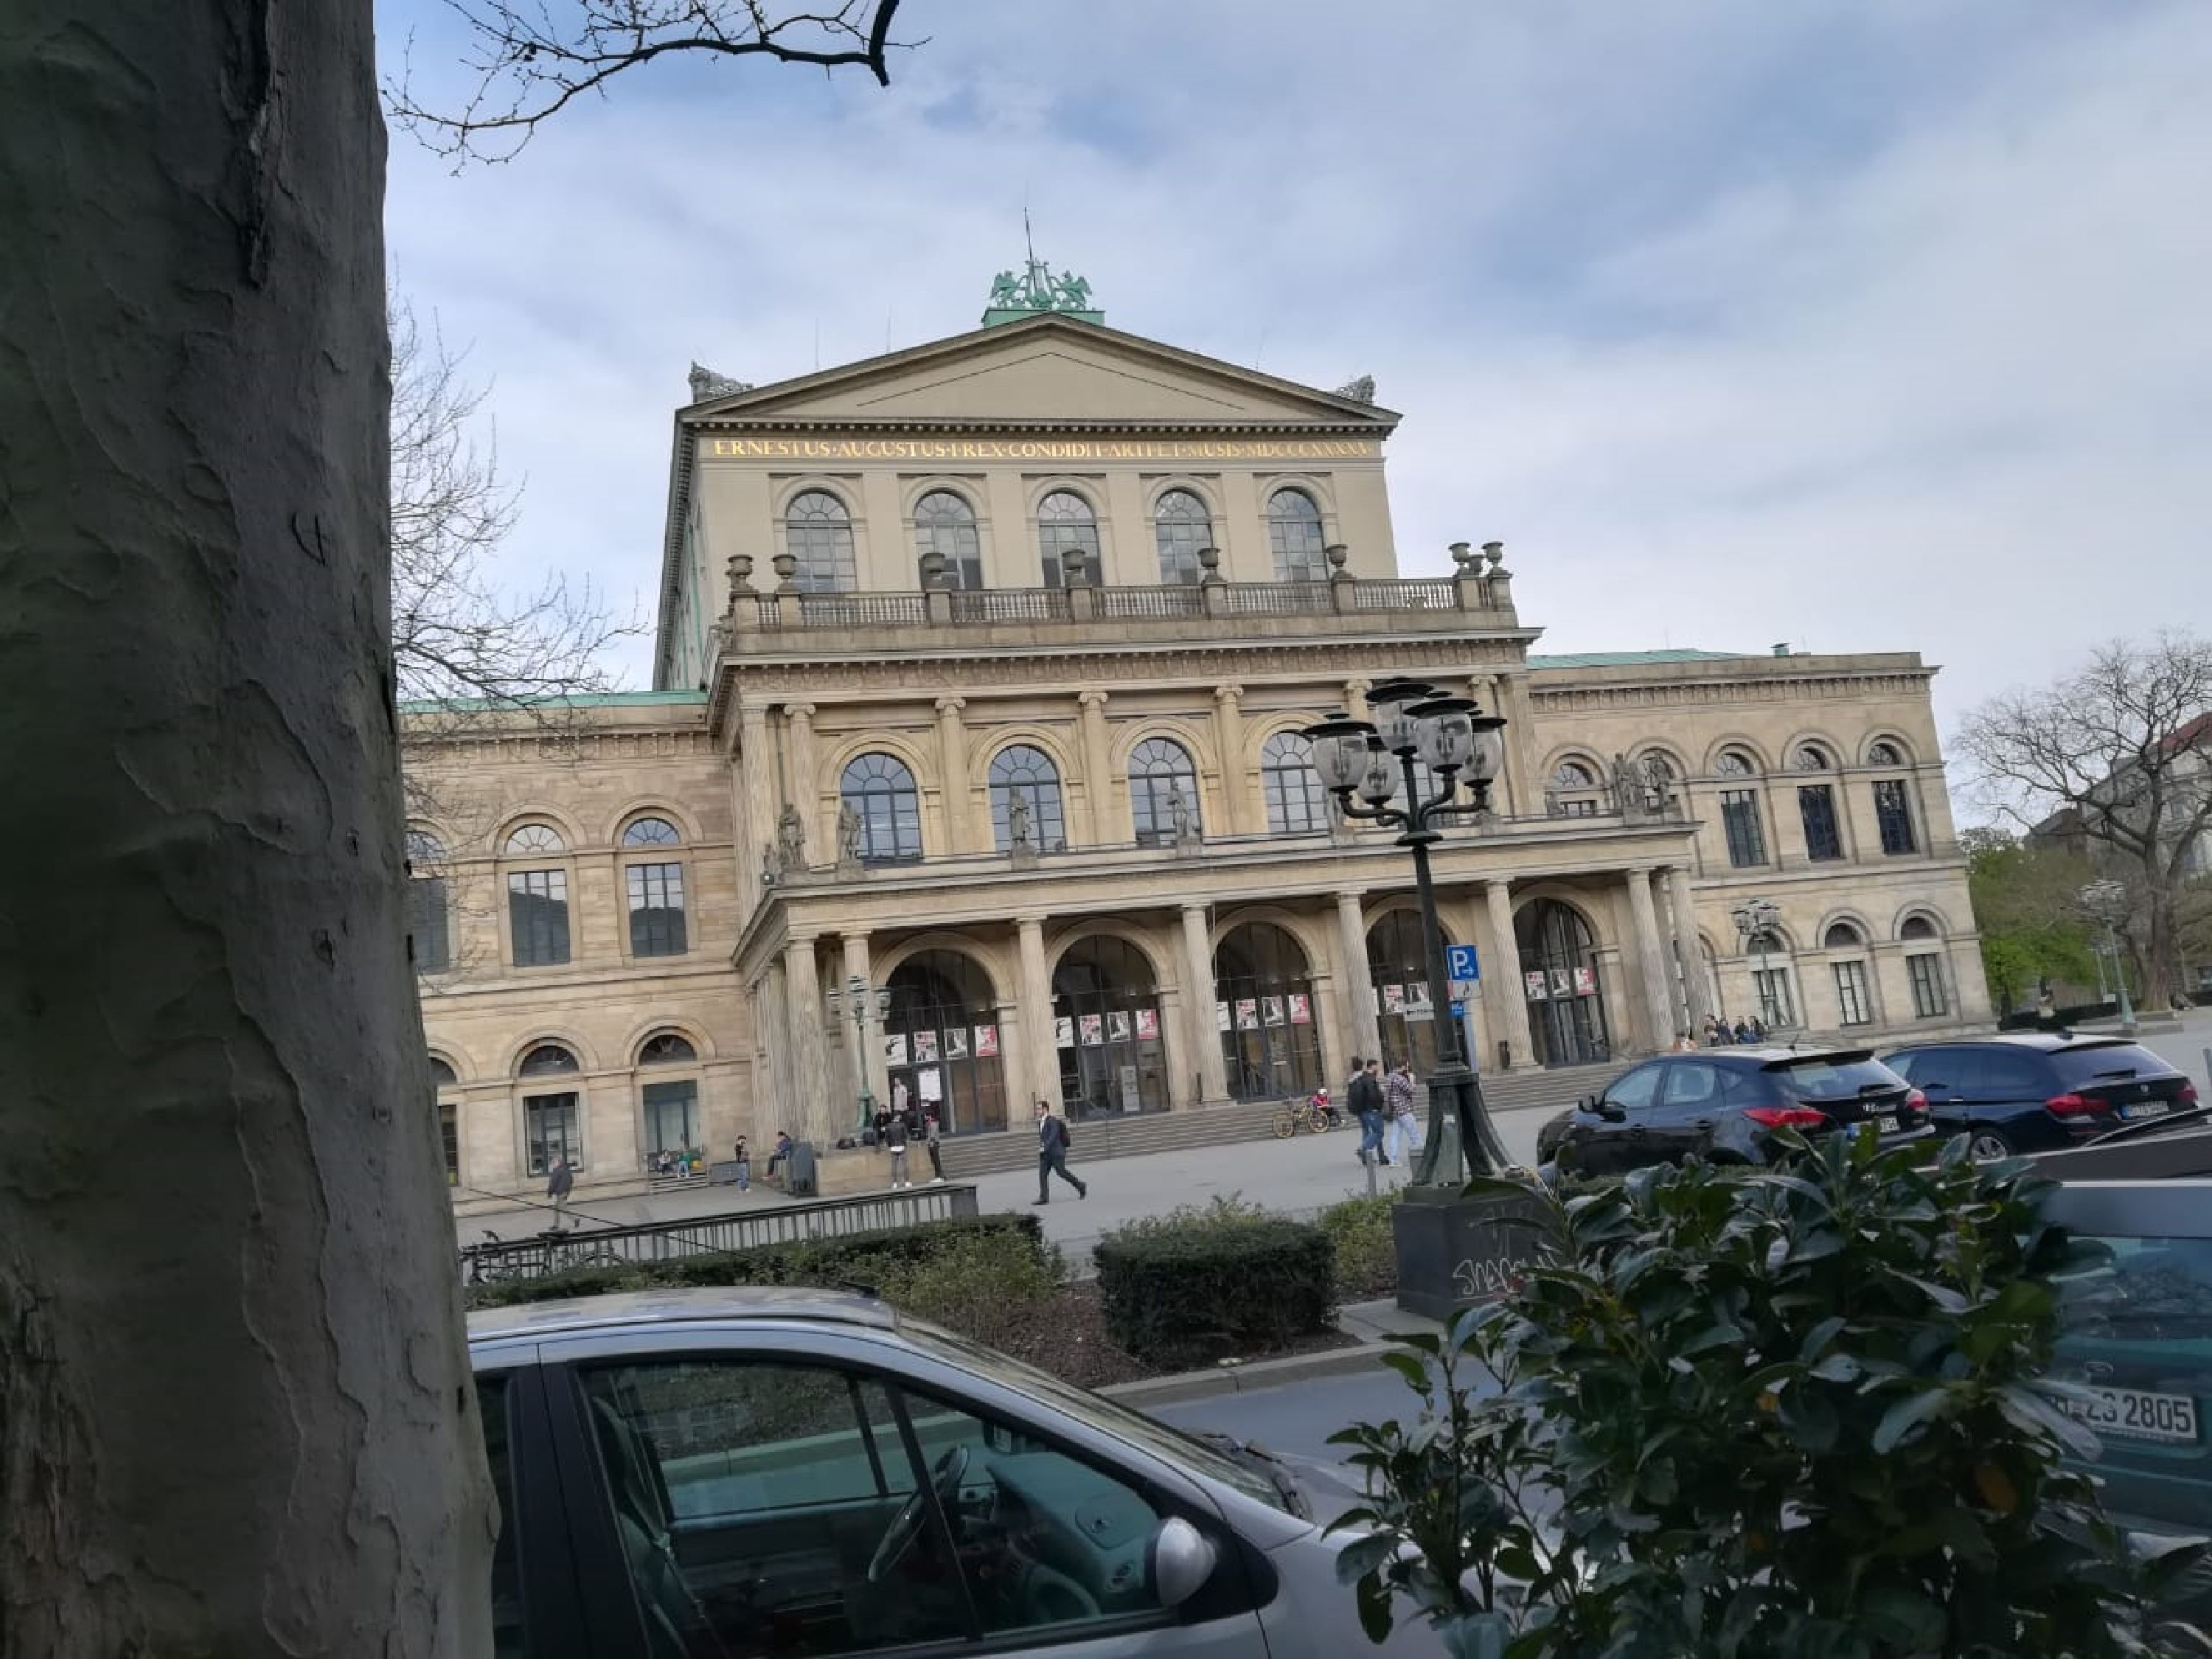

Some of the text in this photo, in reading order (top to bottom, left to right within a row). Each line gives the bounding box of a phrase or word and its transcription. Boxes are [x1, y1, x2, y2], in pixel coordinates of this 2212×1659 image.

[714, 441, 830, 457] ERNESTUS
[838, 442, 946, 457] AUGUSTUS
[963, 442, 1003, 457] REX
[1009, 442, 1102, 457] CONDIDIT
[1451, 950, 1468, 977] P
[2123, 1394, 2191, 1432] 2805
